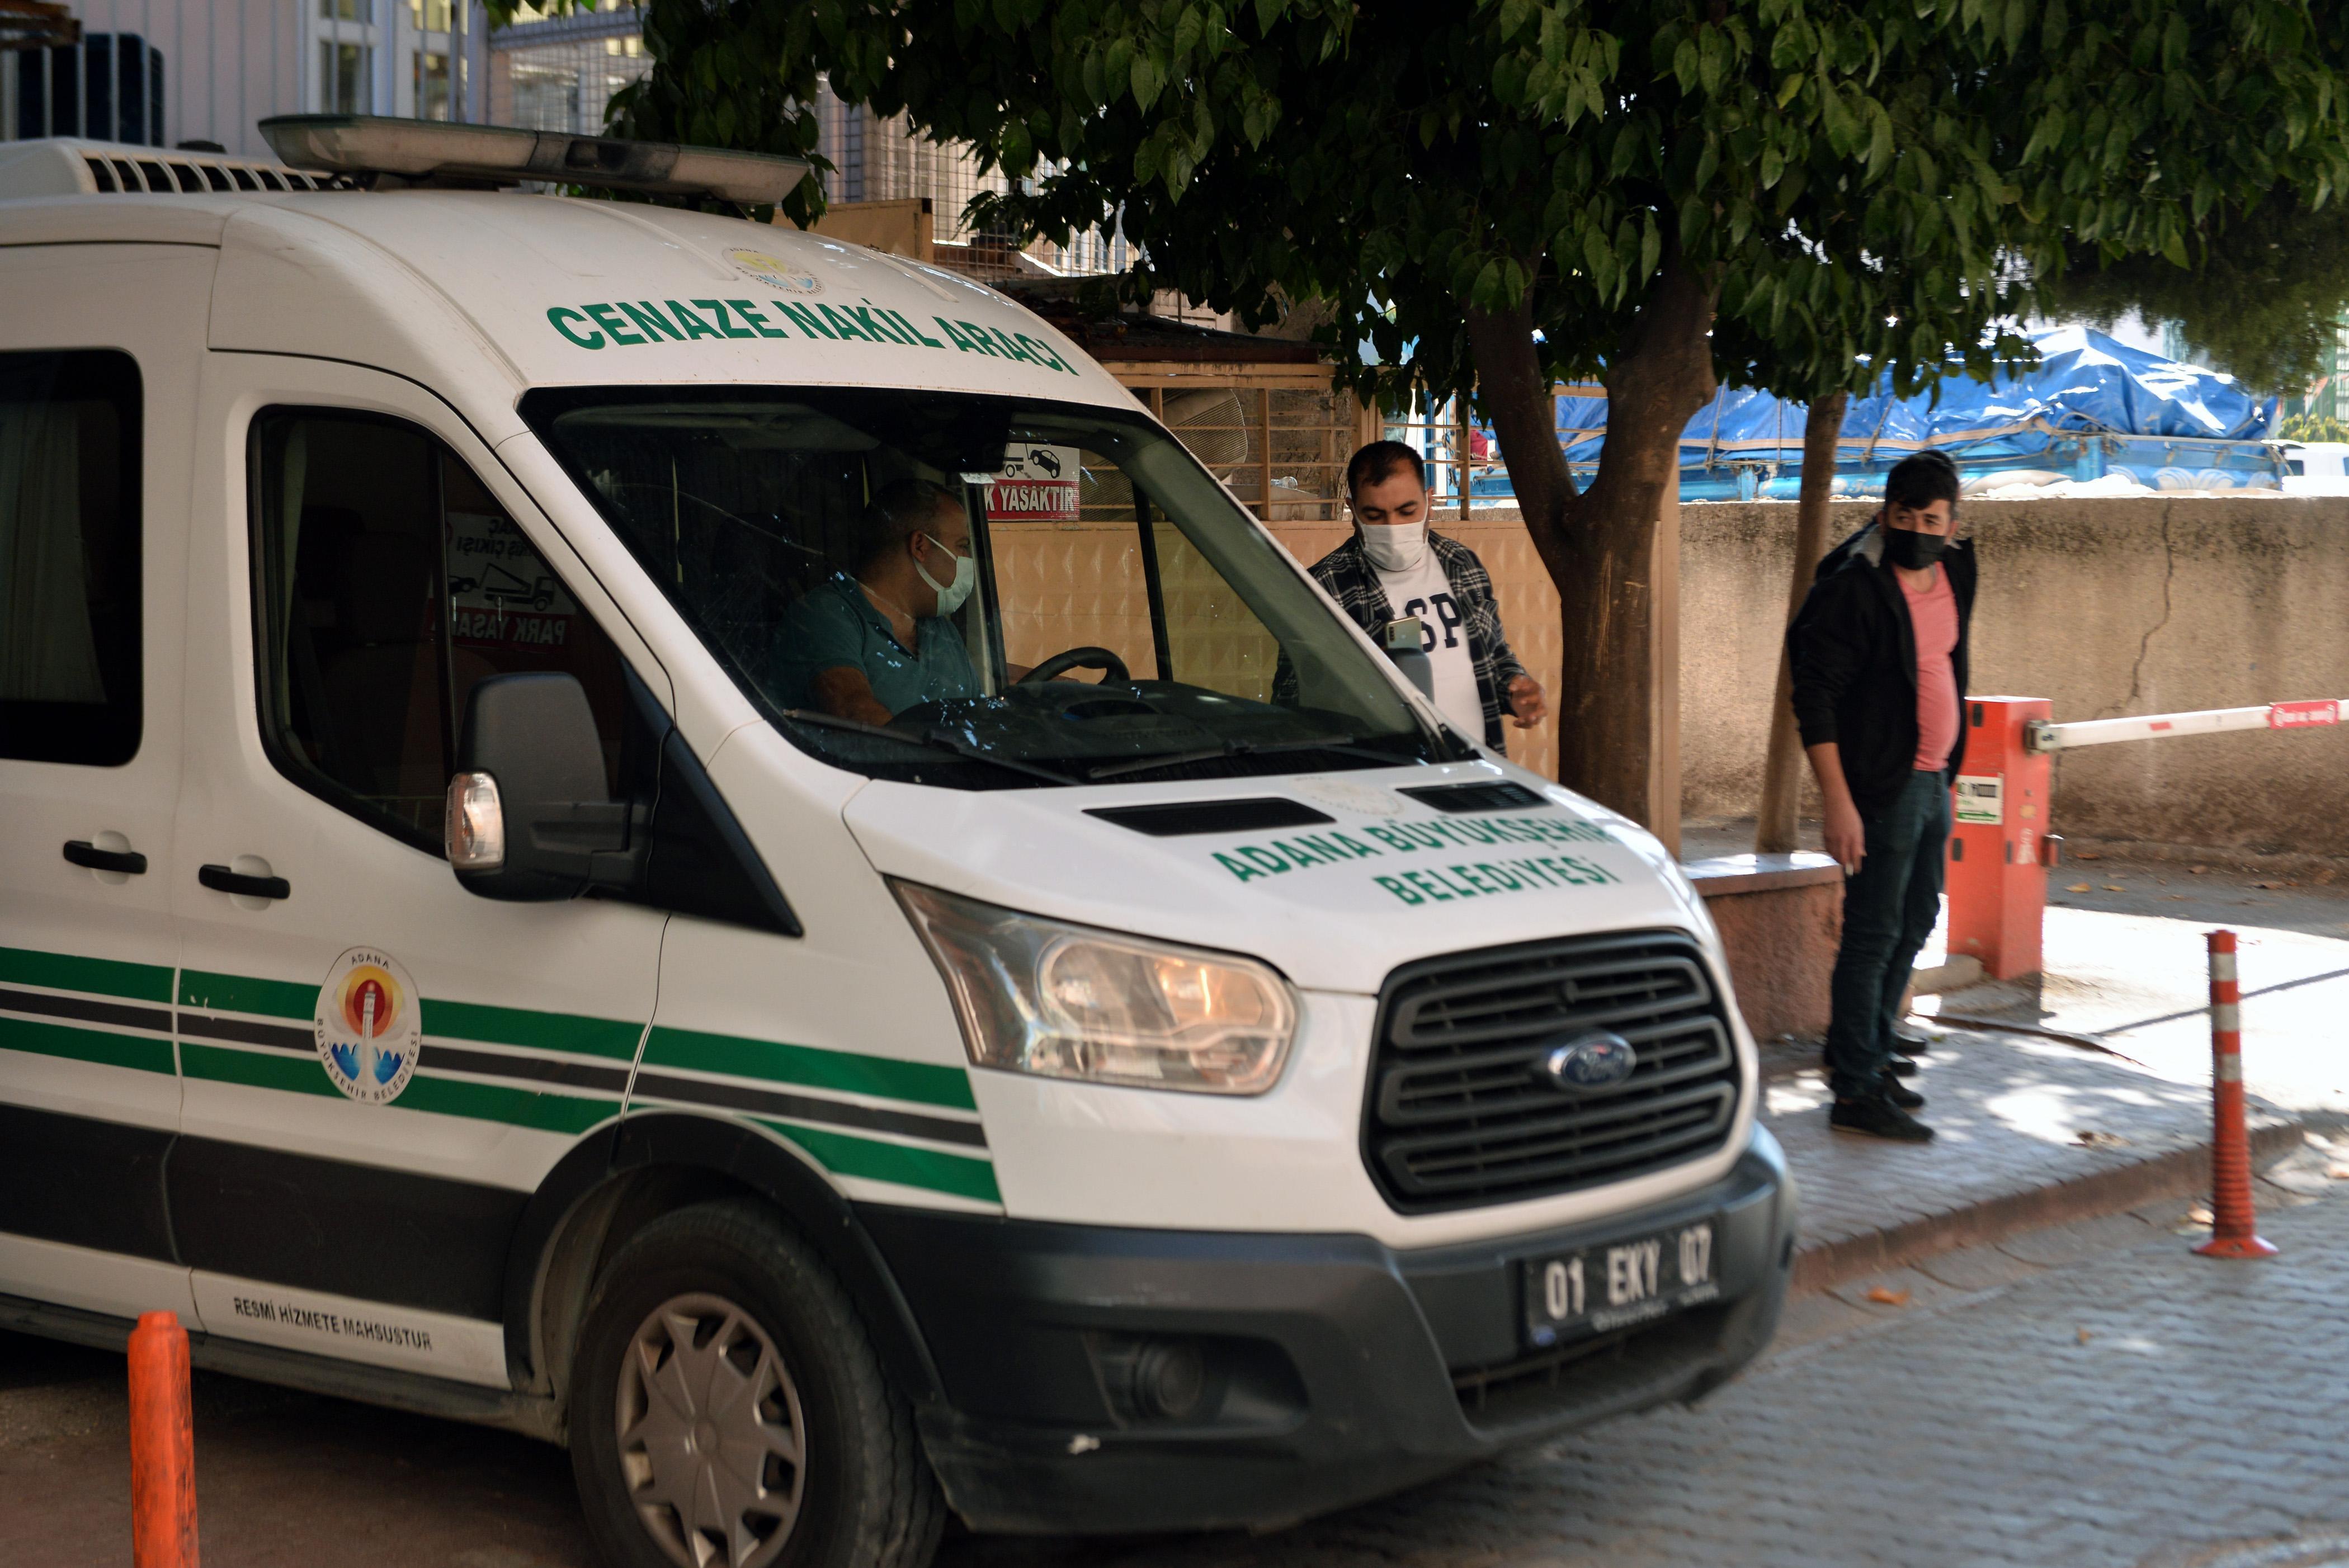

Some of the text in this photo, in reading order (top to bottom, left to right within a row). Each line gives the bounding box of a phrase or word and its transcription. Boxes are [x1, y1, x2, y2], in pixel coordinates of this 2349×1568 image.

[546, 297, 1081, 376] CENAZE NAKİL ARACI
[984, 485, 1074, 512] K YASAKTIR
[1210, 832, 1384, 882] ADANA
[1371, 855, 1622, 906] BELEDİYESİ
[351, 953, 390, 970] ADANA
[1545, 1258, 1585, 1320] 01
[1607, 1239, 1661, 1307] EKY
[234, 1296, 432, 1351] RESMİ HİZMETE MAHSUSTUR
